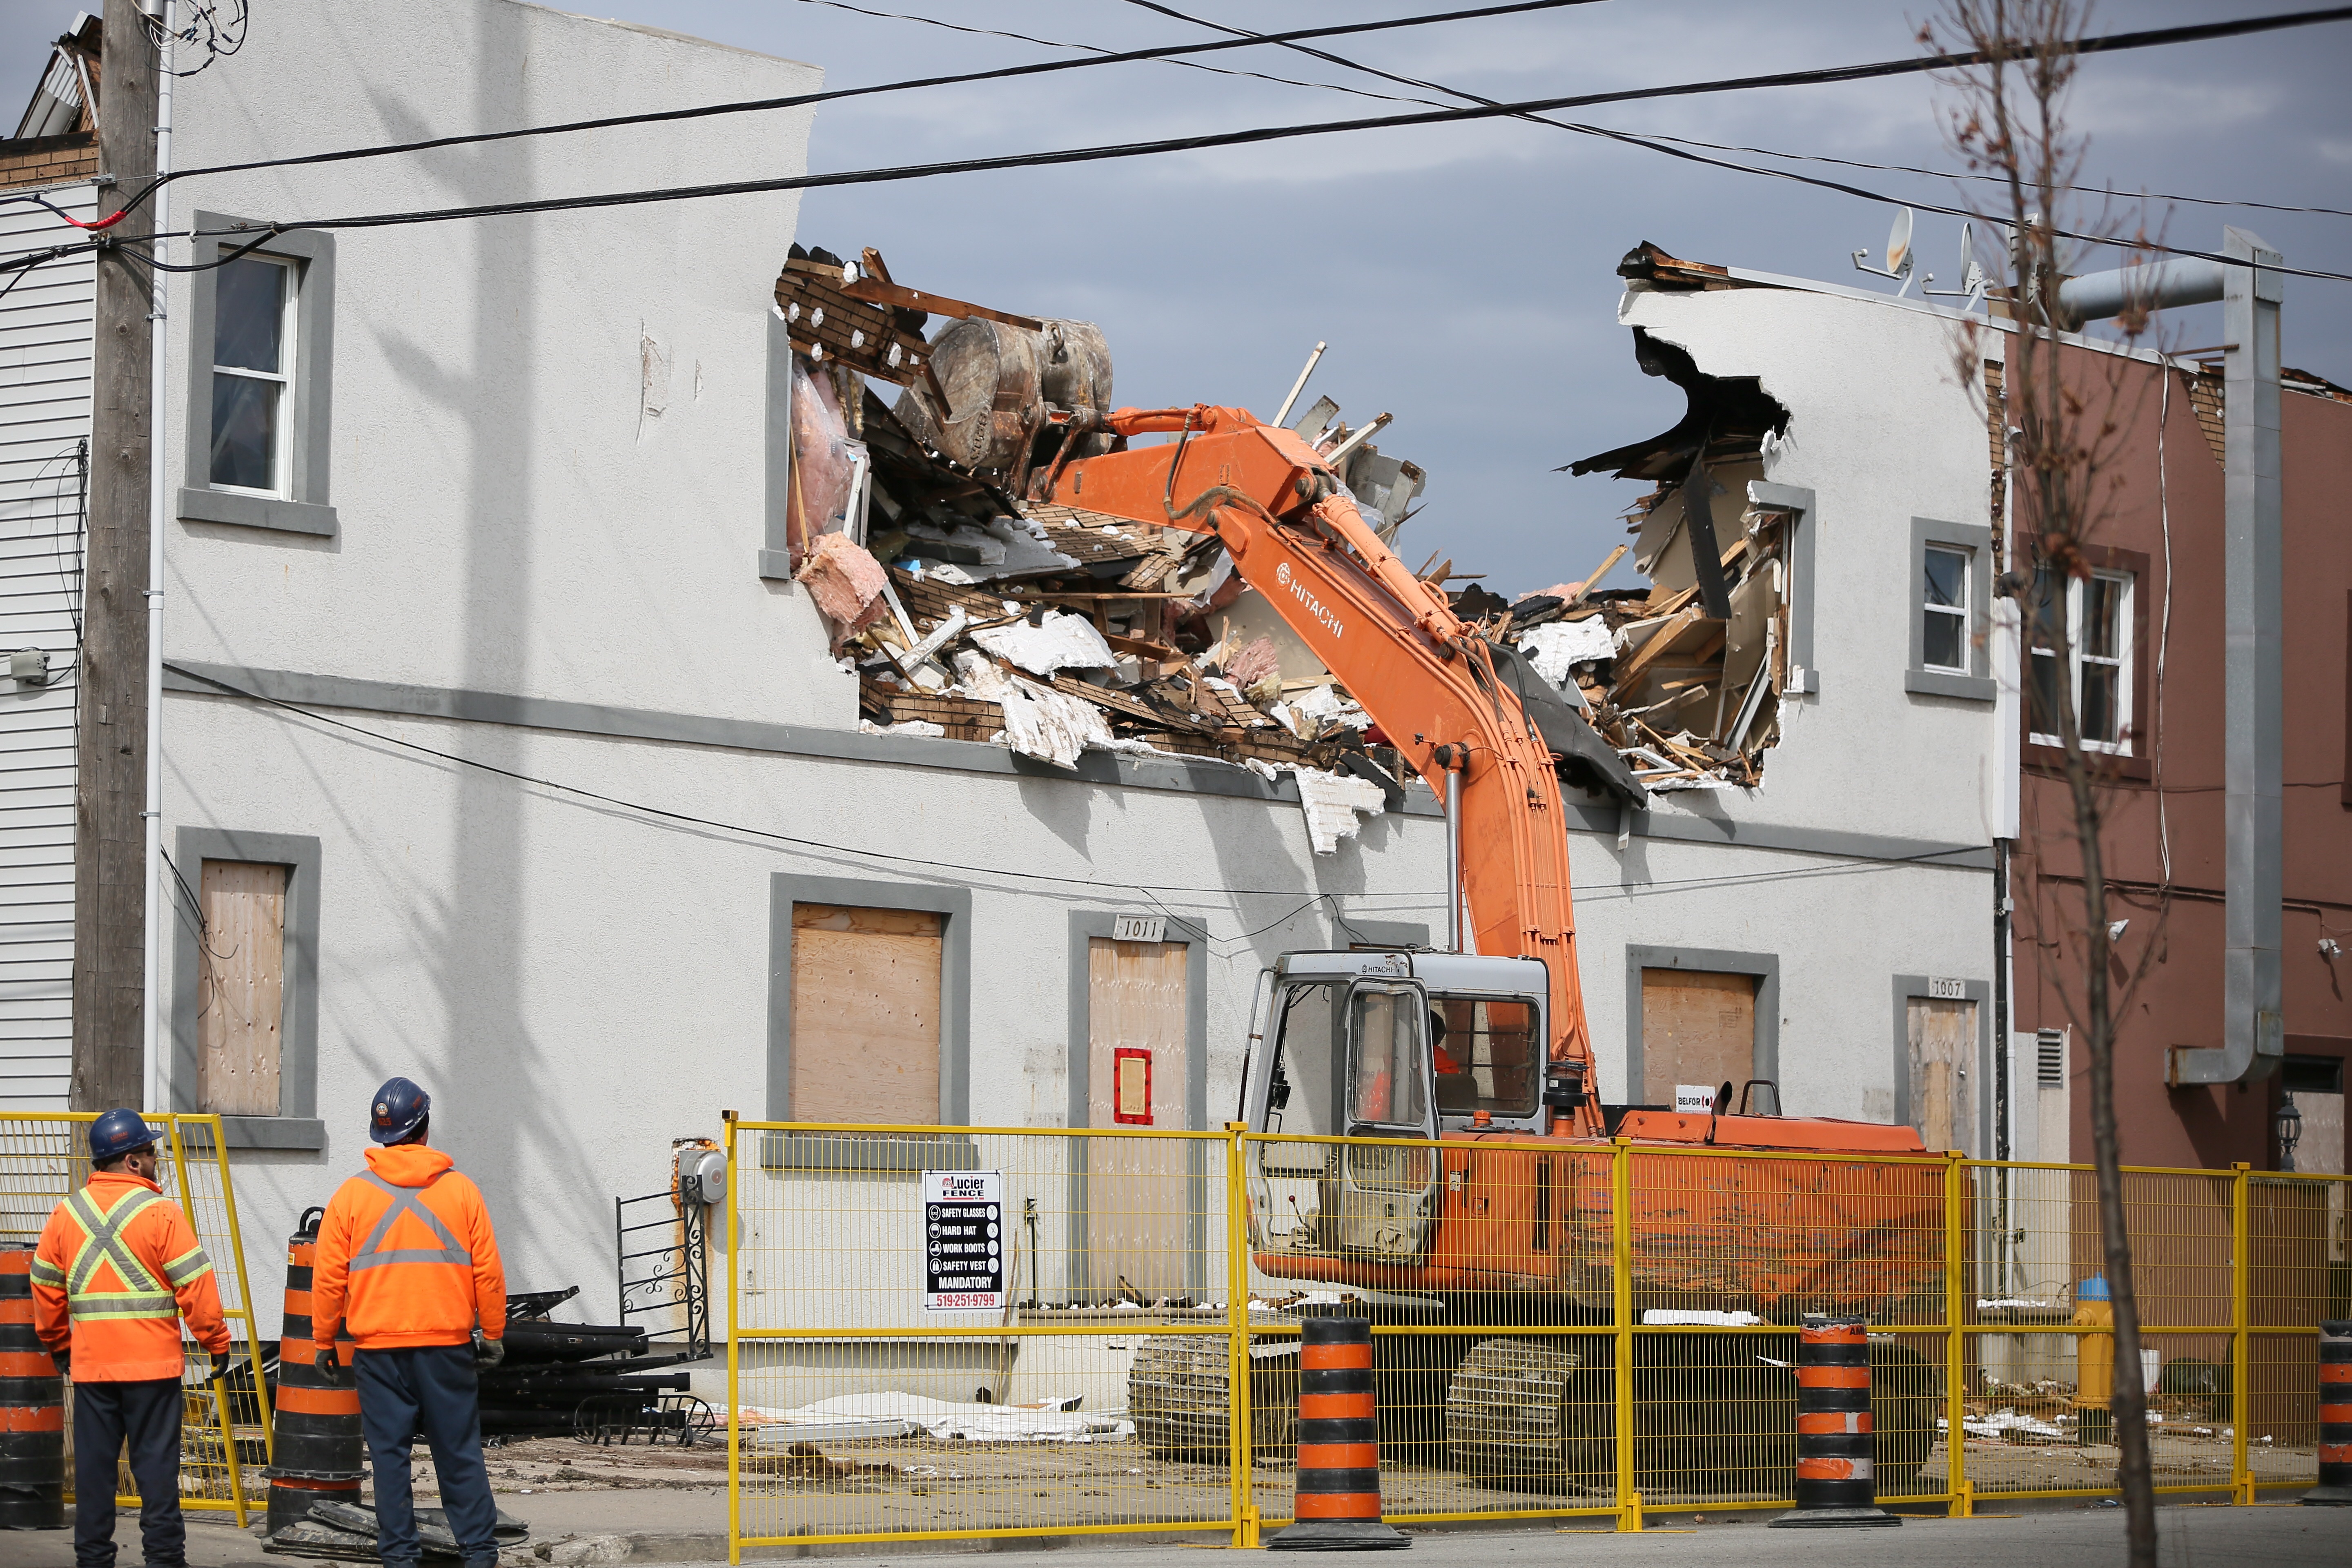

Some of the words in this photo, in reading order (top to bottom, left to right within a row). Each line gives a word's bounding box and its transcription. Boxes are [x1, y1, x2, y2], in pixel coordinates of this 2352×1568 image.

[1290, 579, 1343, 638] HITACHI
[1125, 920, 1157, 938] 1011
[1935, 980, 1961, 996] 1007
[1678, 1097, 1700, 1106] BELFOR
[951, 1176, 984, 1189] Lucier
[942, 1208, 961, 1218] SAFETY
[963, 1208, 986, 1218] GLASSES
[942, 1226, 961, 1236] HARD
[964, 1226, 977, 1235] HAT
[942, 1244, 963, 1253] WORK
[964, 1243, 985, 1253] BOOTS
[943, 1261, 968, 1271] SAFETY
[969, 1261, 986, 1270] VEST
[938, 1276, 992, 1289] MANDATORY
